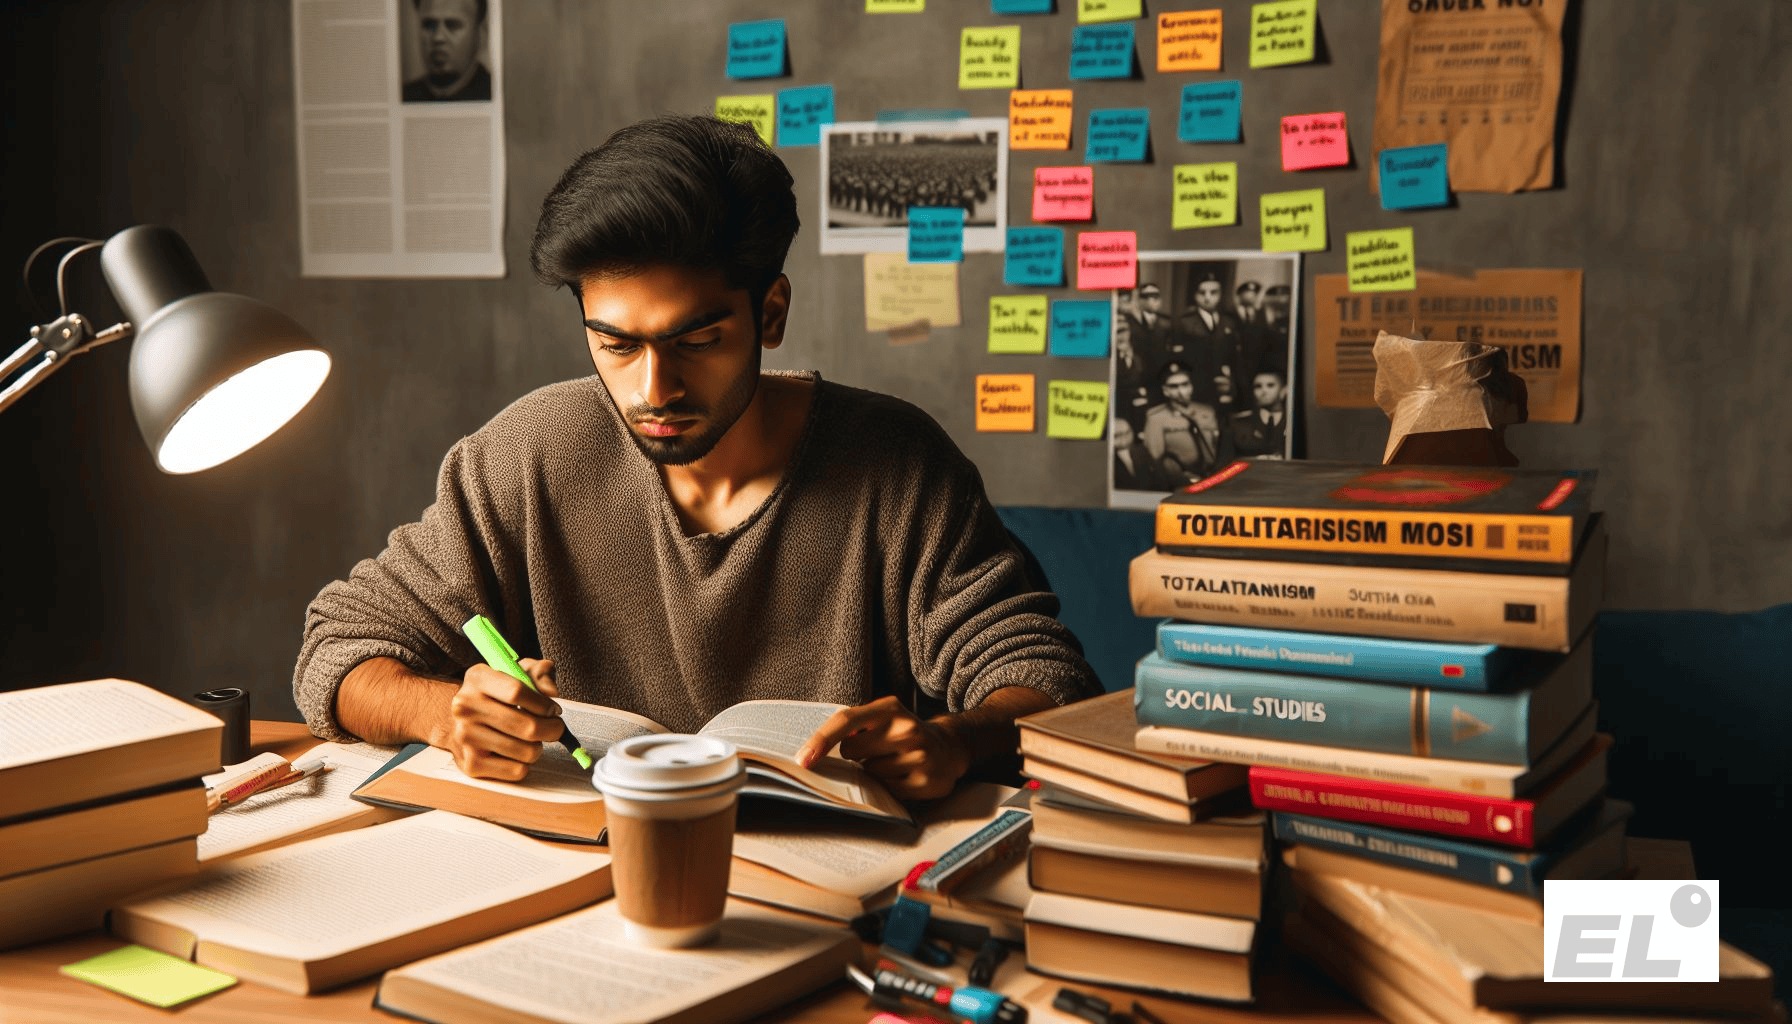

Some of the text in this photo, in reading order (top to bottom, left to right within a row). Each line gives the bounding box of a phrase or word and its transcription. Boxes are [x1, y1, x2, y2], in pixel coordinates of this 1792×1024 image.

[1506, 344, 1562, 369] ISM
[1177, 514, 1473, 547] TOTALITARISISM MOSI
[1165, 688, 1327, 722] SOCIAL STUDIES
